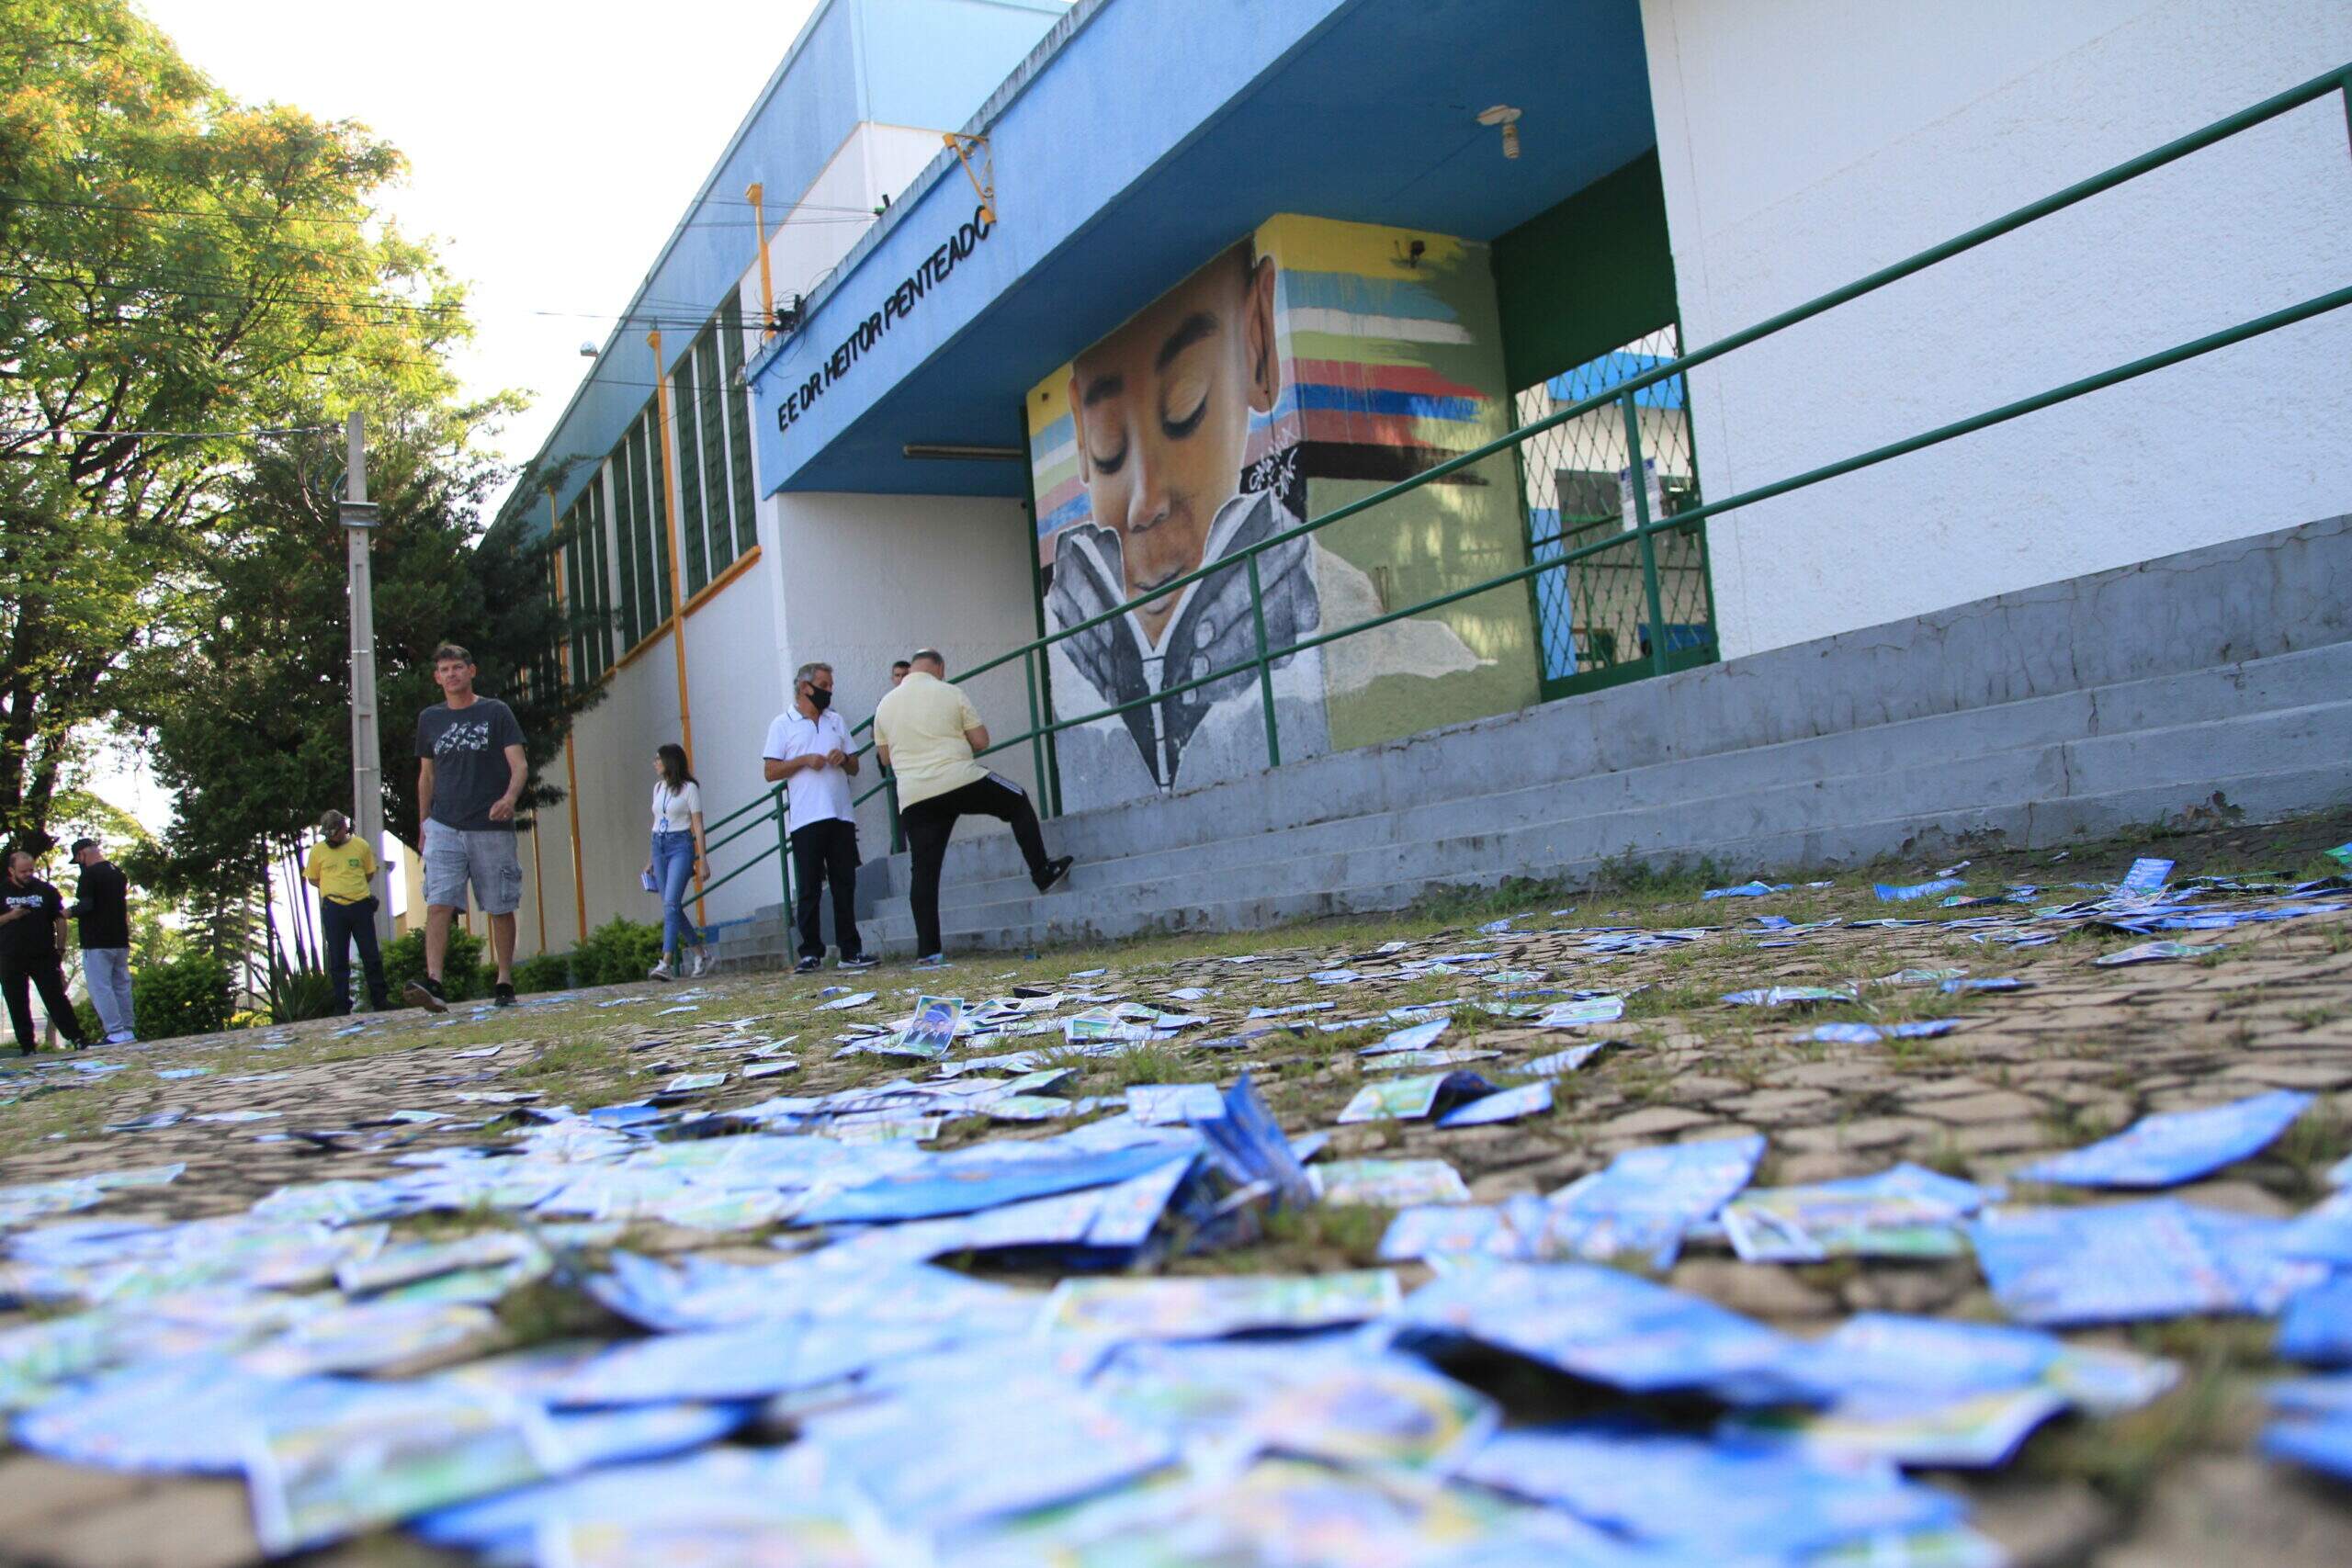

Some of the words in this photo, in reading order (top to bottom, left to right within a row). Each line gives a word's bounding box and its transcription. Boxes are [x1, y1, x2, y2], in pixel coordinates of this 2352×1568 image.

[777, 392, 799, 433] EE
[800, 371, 824, 411] DR
[823, 311, 884, 387] HEITOR
[883, 204, 991, 331] PENTEADO
